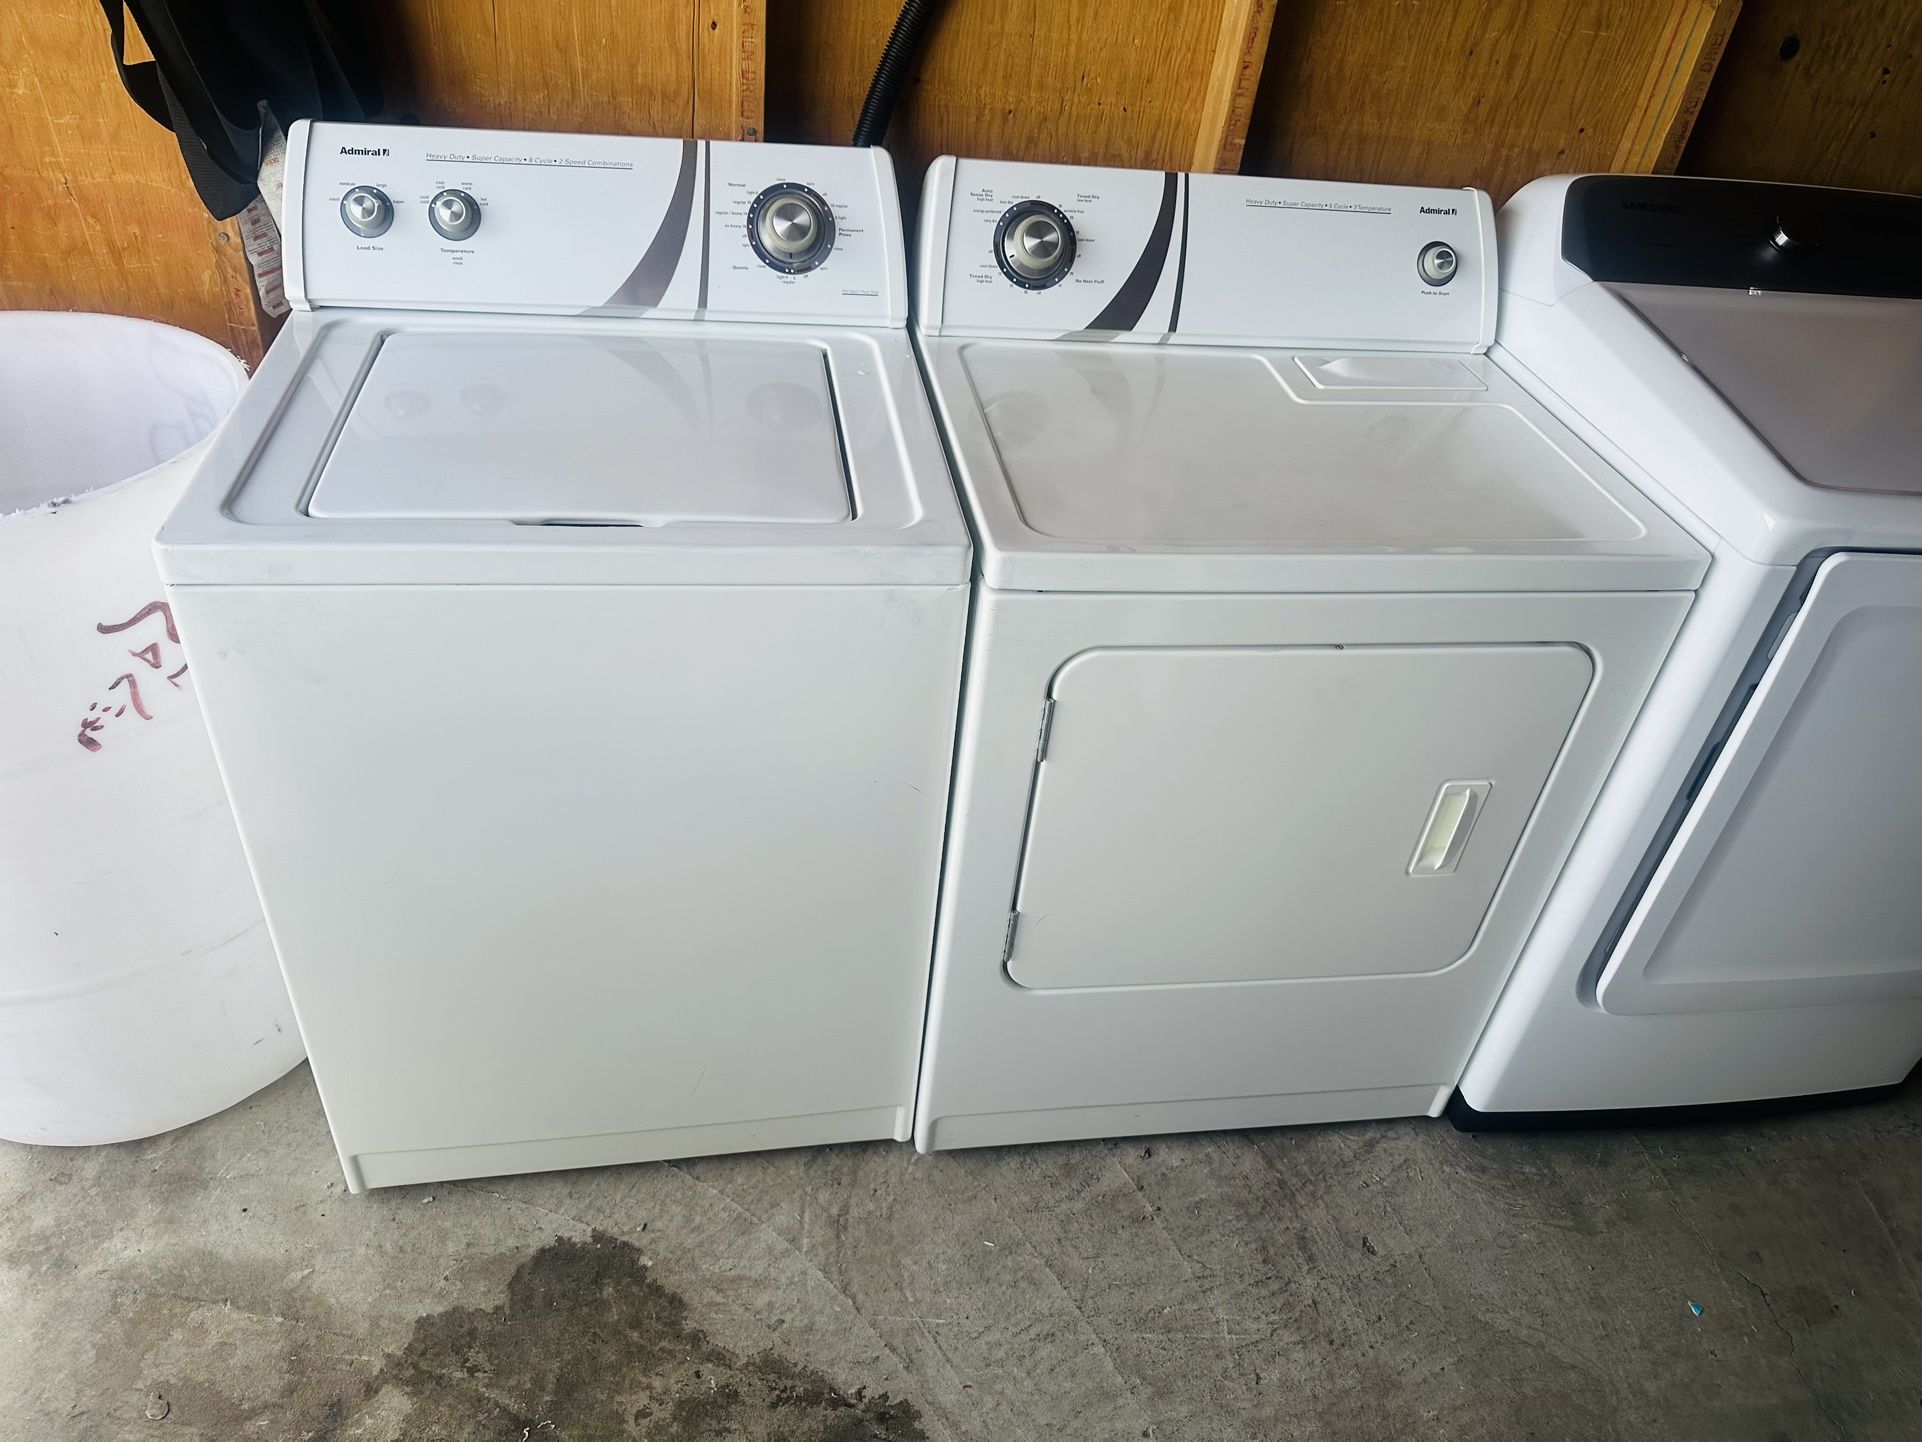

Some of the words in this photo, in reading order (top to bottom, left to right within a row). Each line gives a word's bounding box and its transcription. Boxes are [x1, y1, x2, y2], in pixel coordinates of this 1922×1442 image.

[339, 146, 381, 157] Admiral
[425, 152, 448, 160] Heavy
[449, 153, 466, 161] Duty
[471, 154, 492, 162] Super
[565, 158, 586, 166] Speed
[587, 159, 633, 167] Combinations
[1300, 202, 1324, 210] Capacity
[1358, 204, 1392, 213] Temperature
[1419, 206, 1450, 216] Admiral
